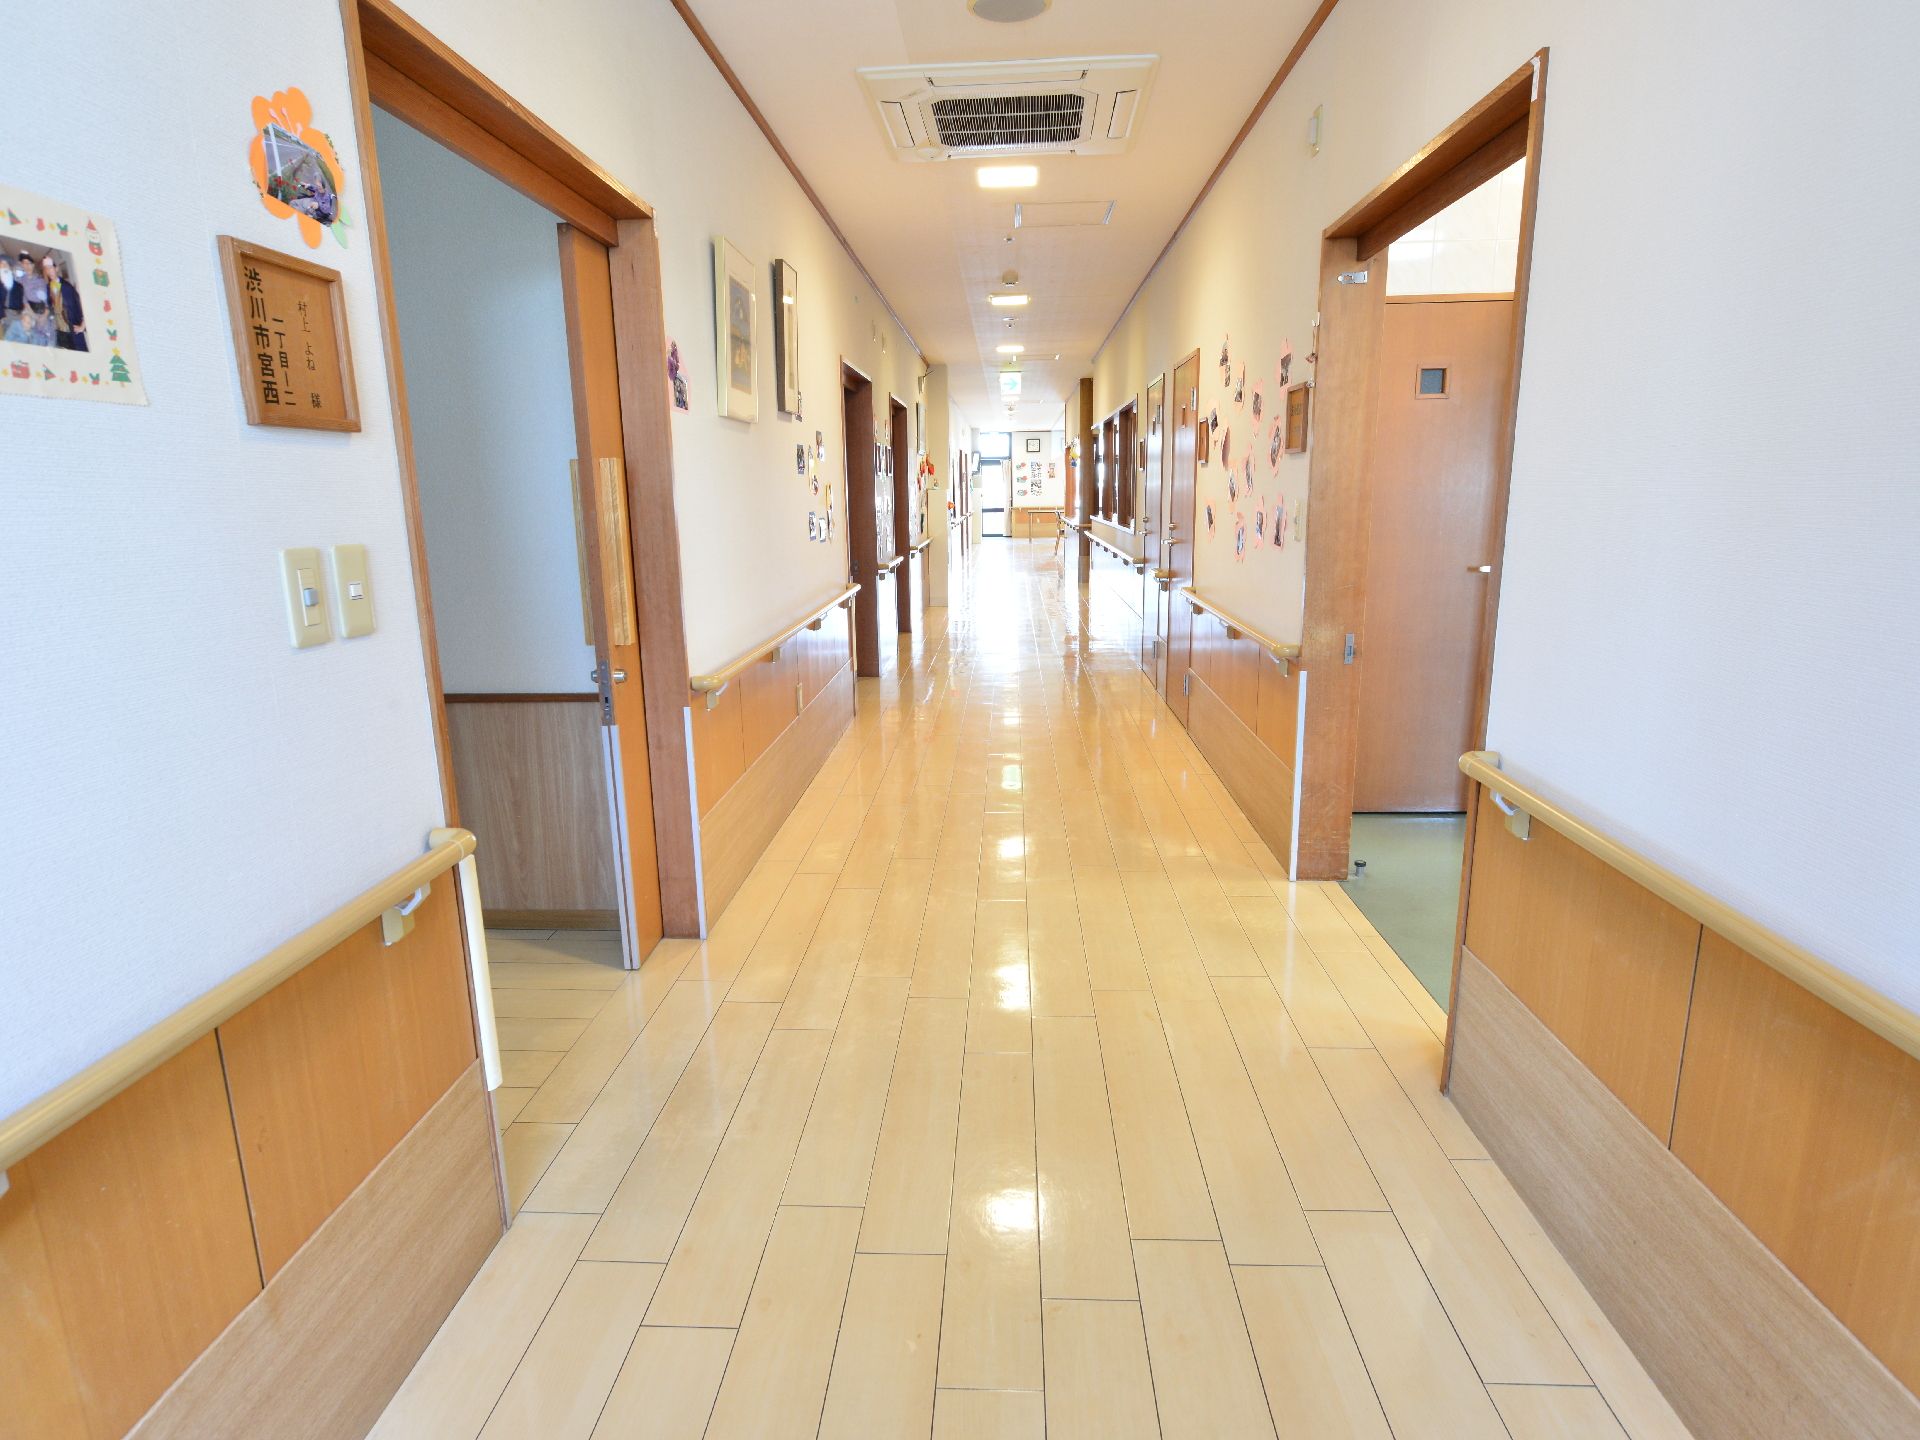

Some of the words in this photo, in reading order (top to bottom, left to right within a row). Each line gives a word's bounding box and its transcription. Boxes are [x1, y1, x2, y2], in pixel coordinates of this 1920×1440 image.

[244, 266, 280, 405] 渋川市宮西
